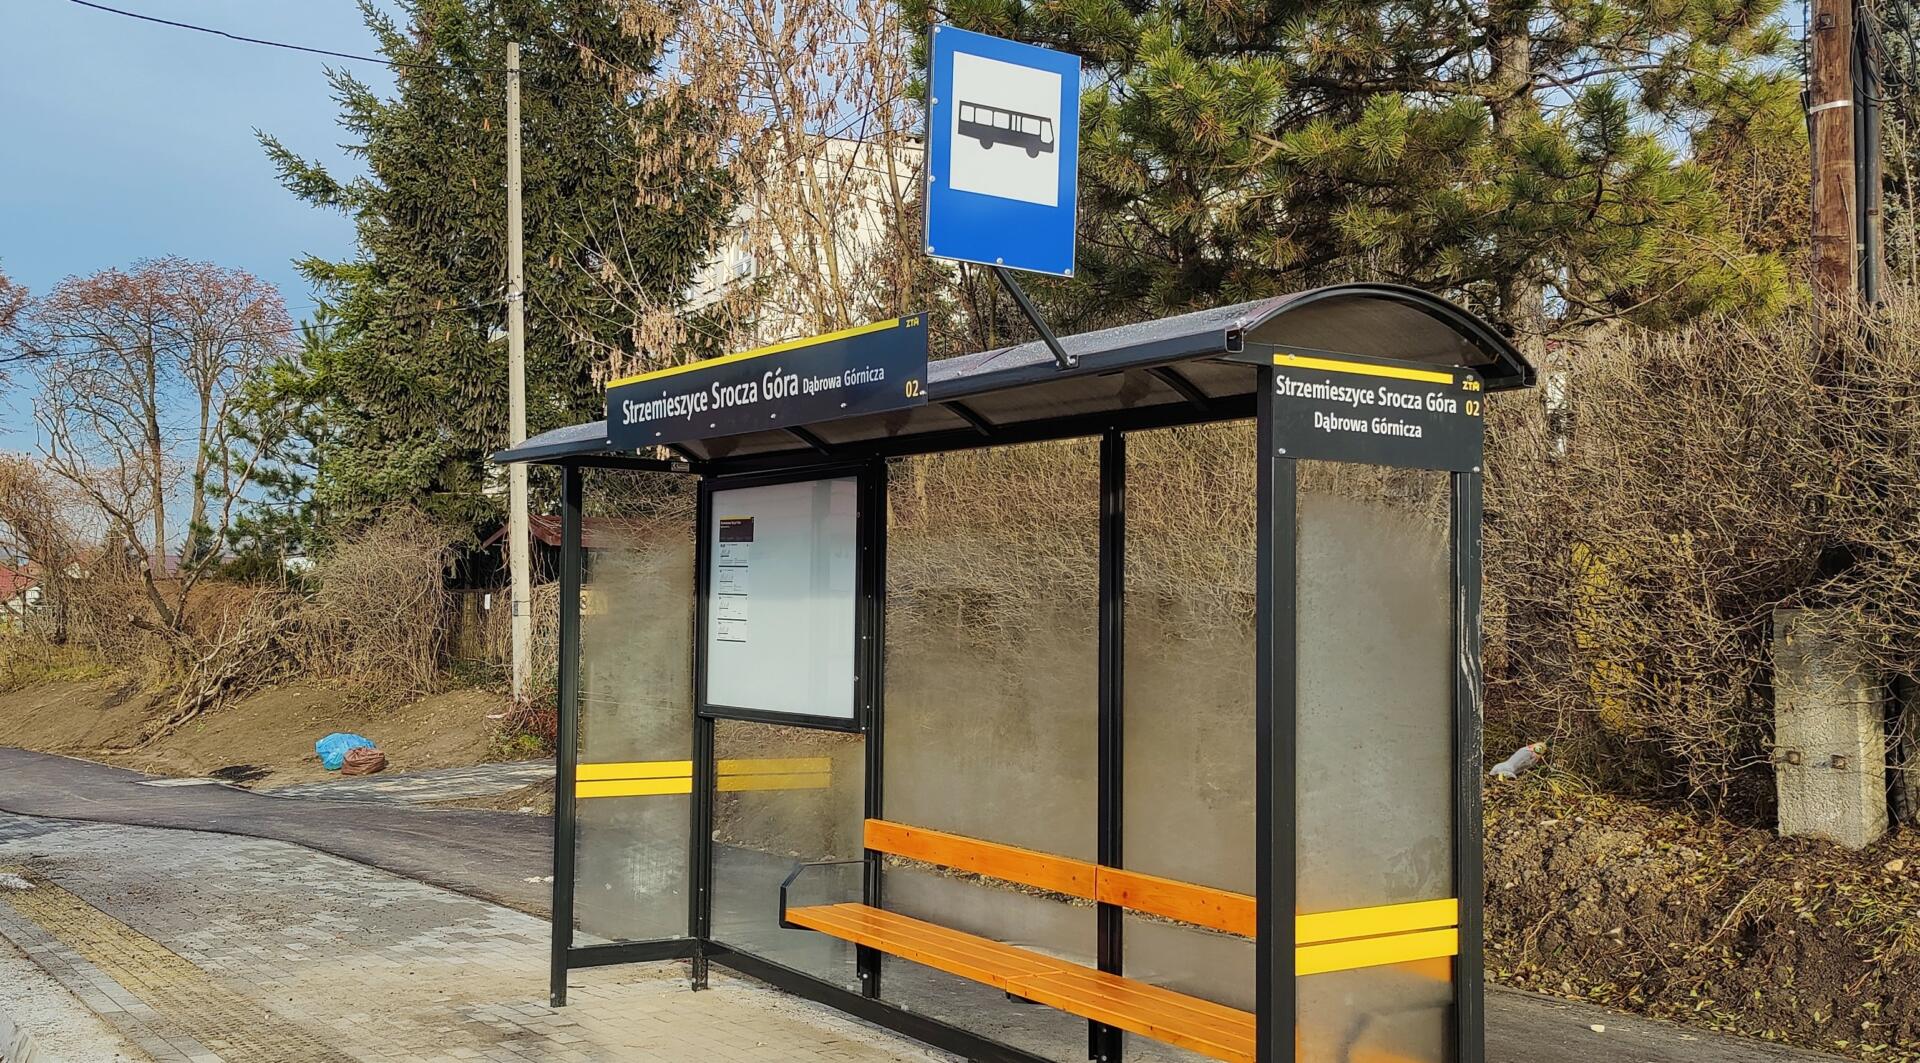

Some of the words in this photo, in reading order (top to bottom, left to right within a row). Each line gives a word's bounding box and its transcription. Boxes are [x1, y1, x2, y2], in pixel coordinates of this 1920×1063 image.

[622, 390, 708, 421] Strzemieszyce
[711, 380, 758, 410] Srocza
[762, 367, 799, 400] Góra
[802, 376, 842, 397] Dąbrowa
[843, 365, 885, 387] Górnicza
[905, 380, 919, 399] 02
[1276, 375, 1375, 408] Strzemieszyce
[1378, 387, 1423, 411] Srocza
[1426, 392, 1457, 414] Góra
[1465, 400, 1480, 417] 02
[1314, 411, 1368, 433] Dąbrowa
[1371, 417, 1423, 439] Górnicza
